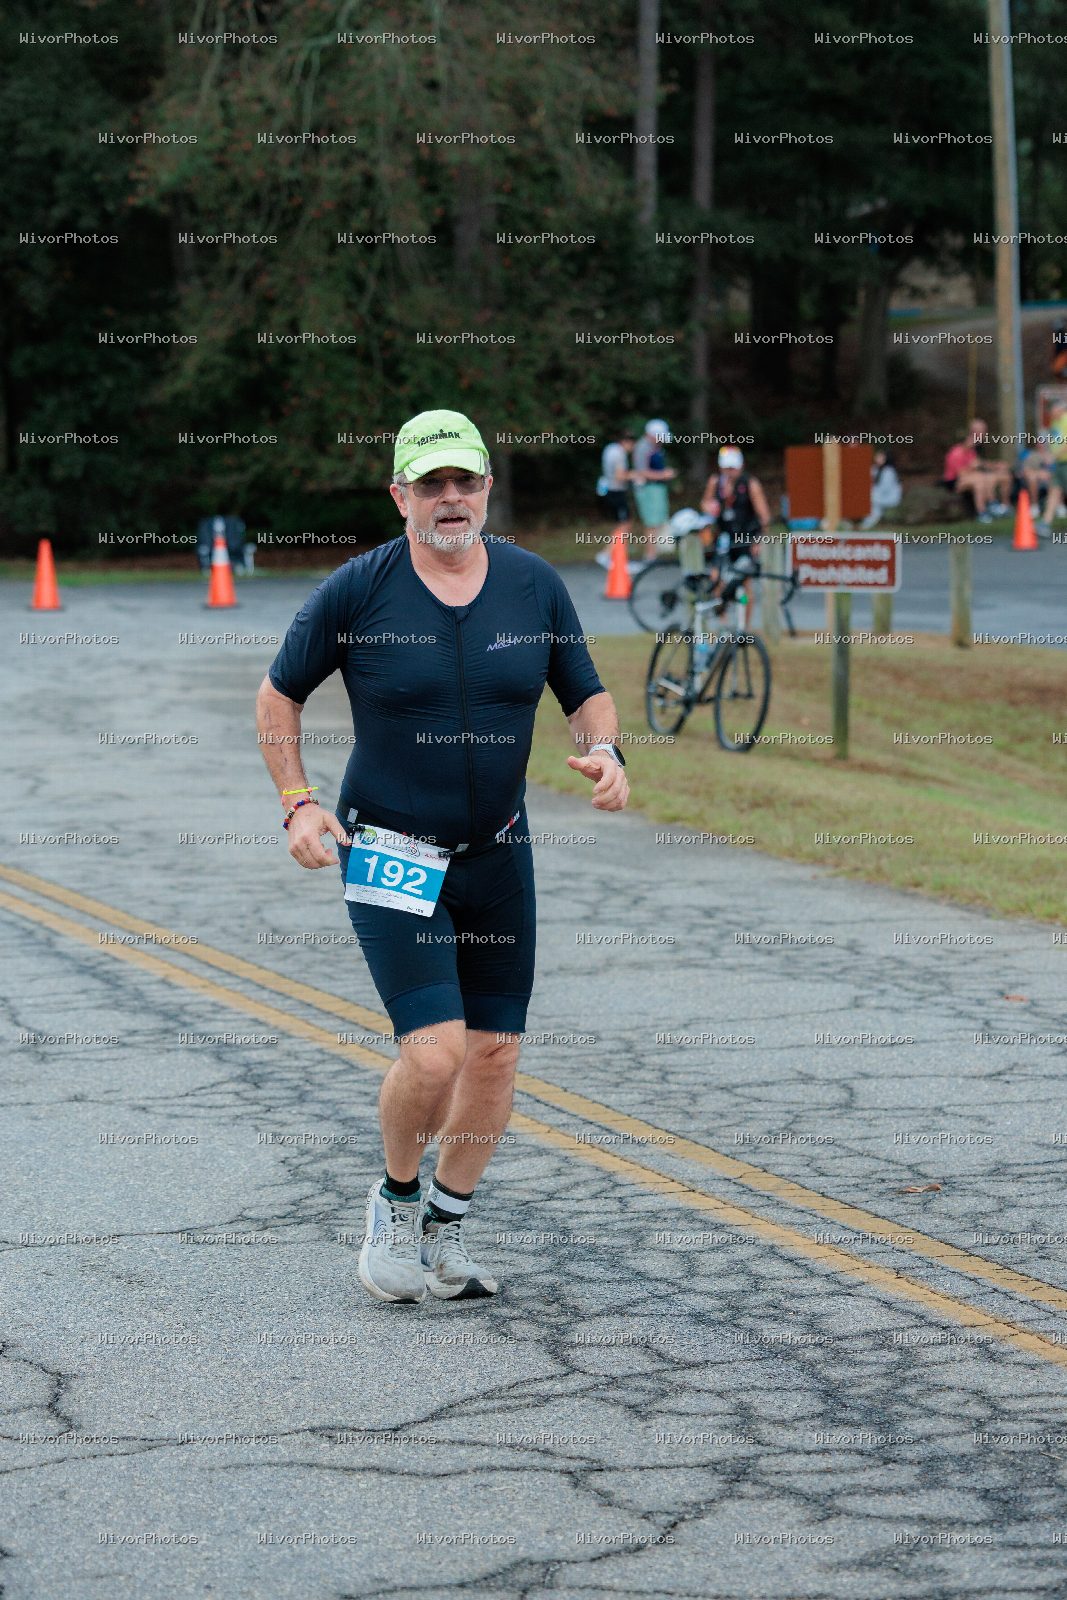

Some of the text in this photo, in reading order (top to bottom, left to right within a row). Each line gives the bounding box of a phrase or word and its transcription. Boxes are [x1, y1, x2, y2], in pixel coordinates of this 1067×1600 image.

[796, 541, 891, 561] Intoxicants
[798, 563, 889, 584] Prohibited
[364, 854, 428, 896] 192
